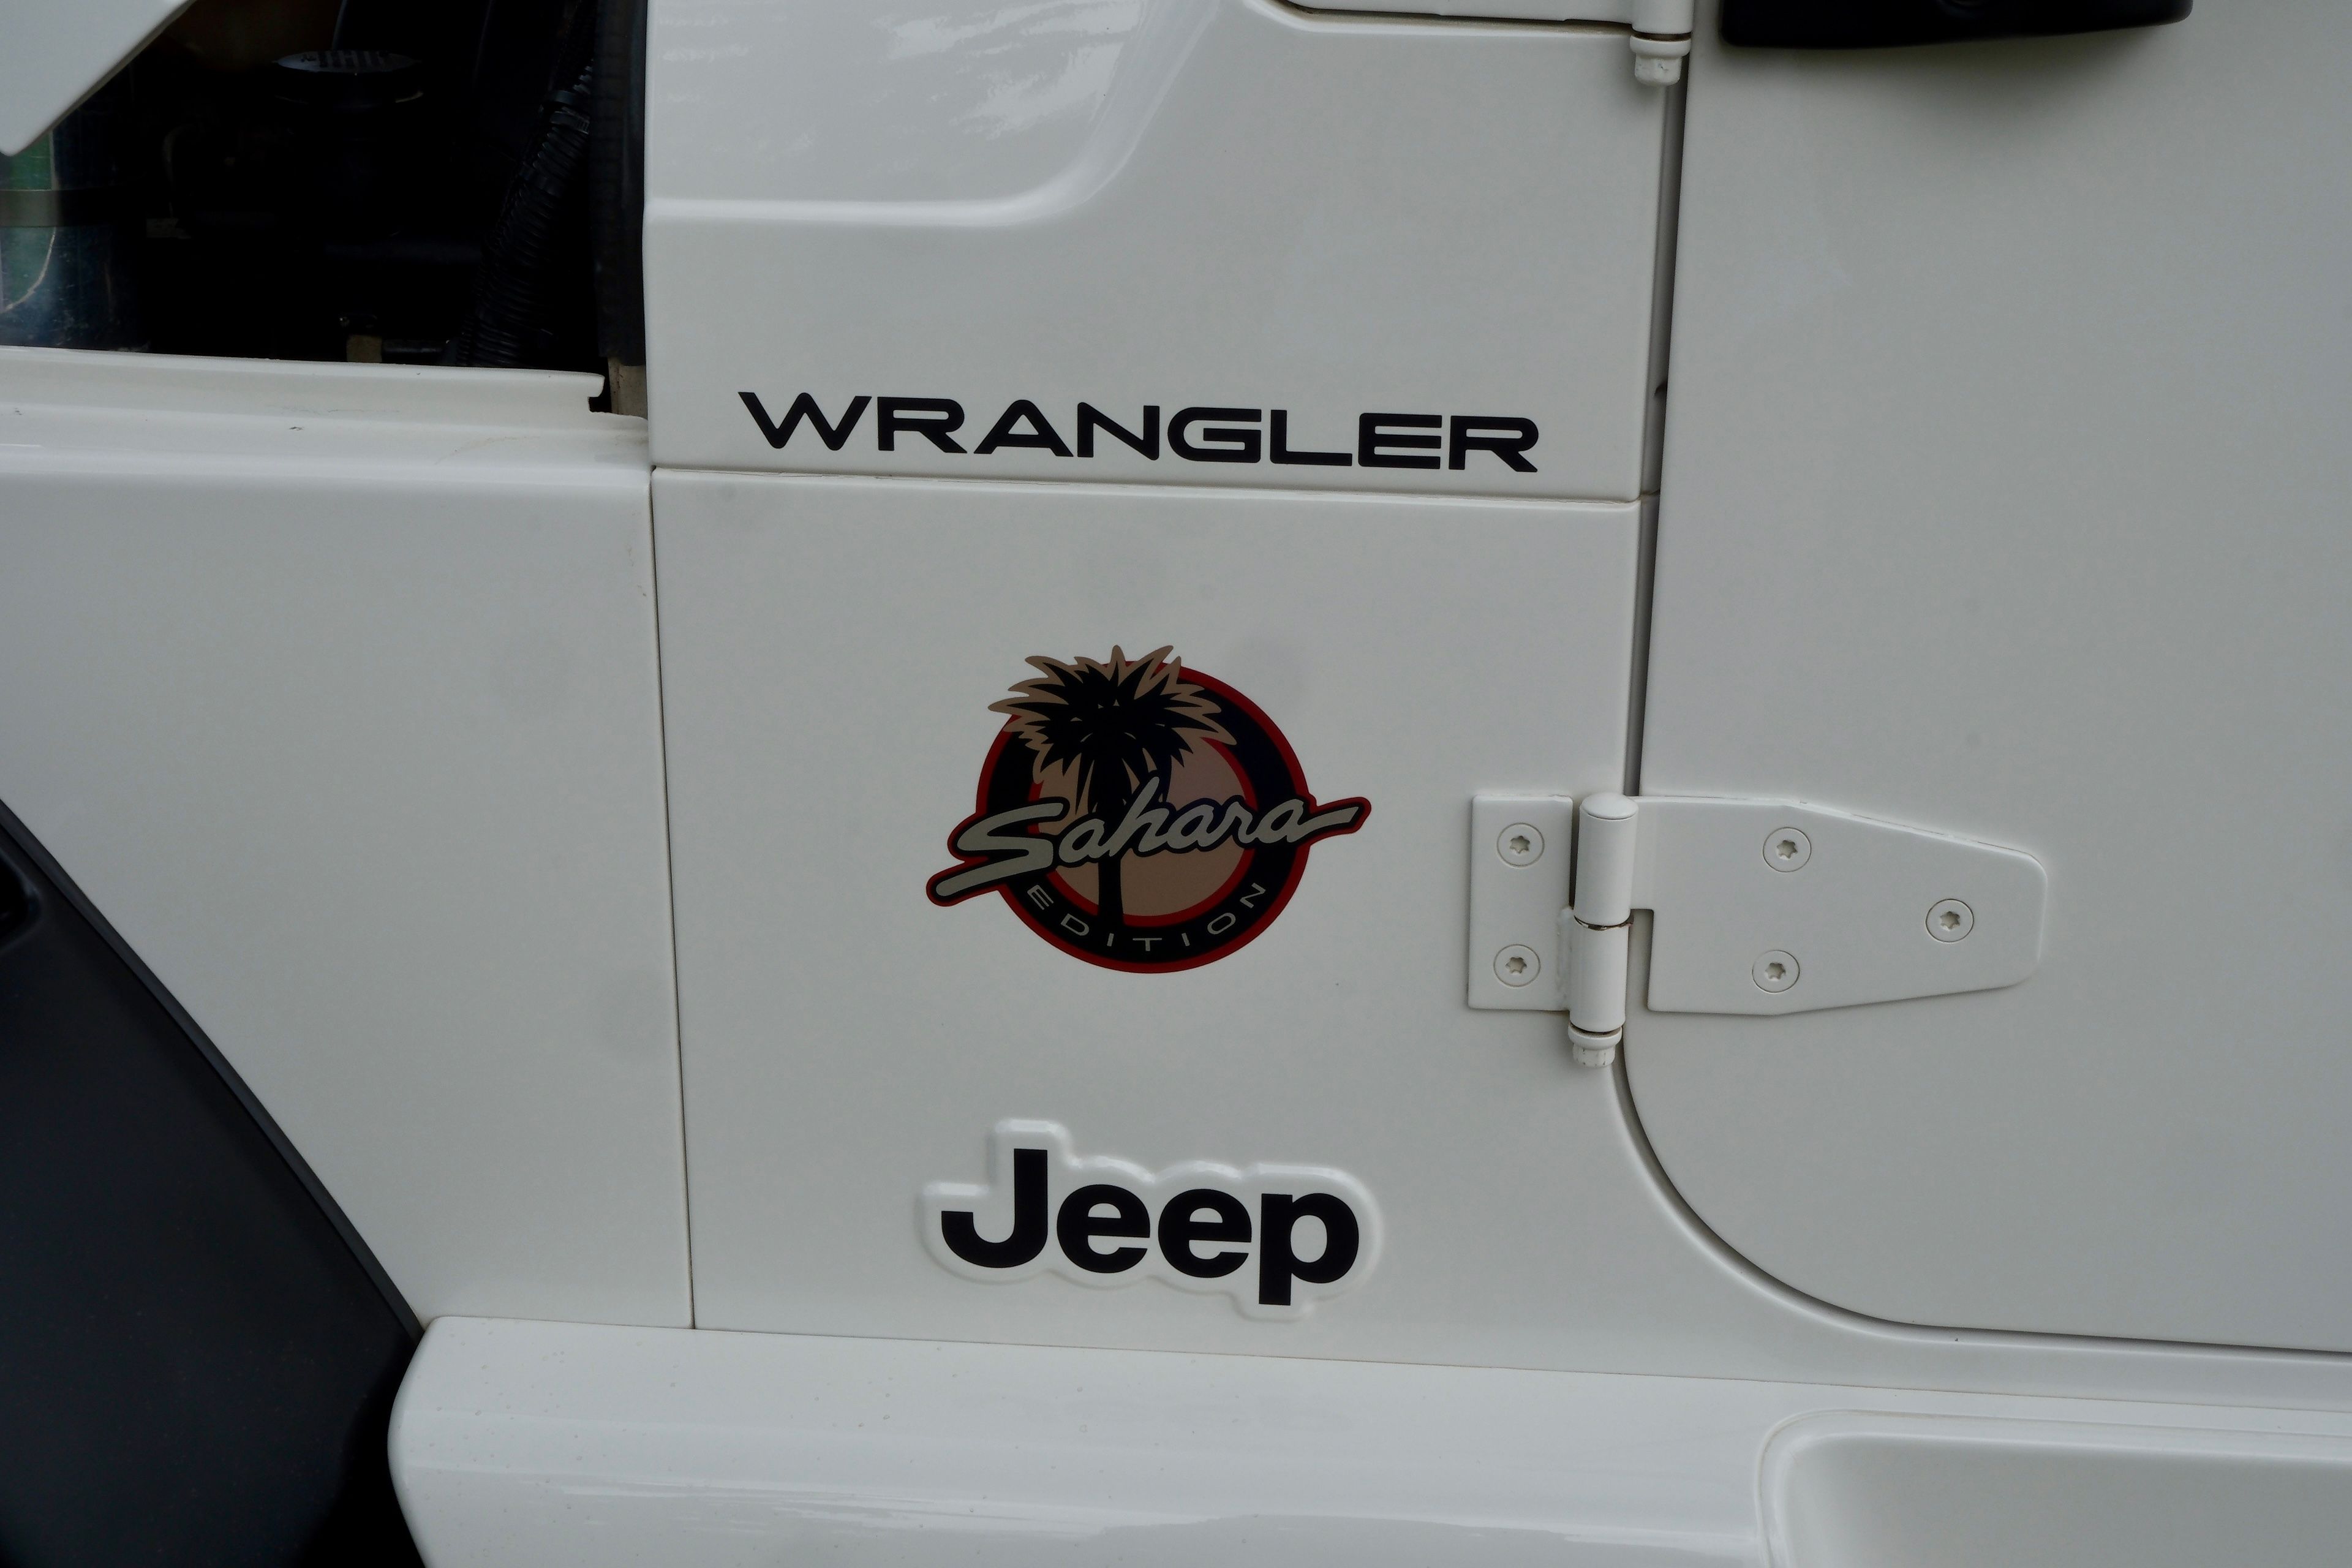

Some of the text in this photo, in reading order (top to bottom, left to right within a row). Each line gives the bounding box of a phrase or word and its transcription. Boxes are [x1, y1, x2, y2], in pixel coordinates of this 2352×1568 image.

[738, 392, 1539, 472] WRANGLER
[936, 777, 1359, 896] Sahara
[1027, 883, 1265, 951] EDITION
[941, 1148, 1359, 1306] Jeep
